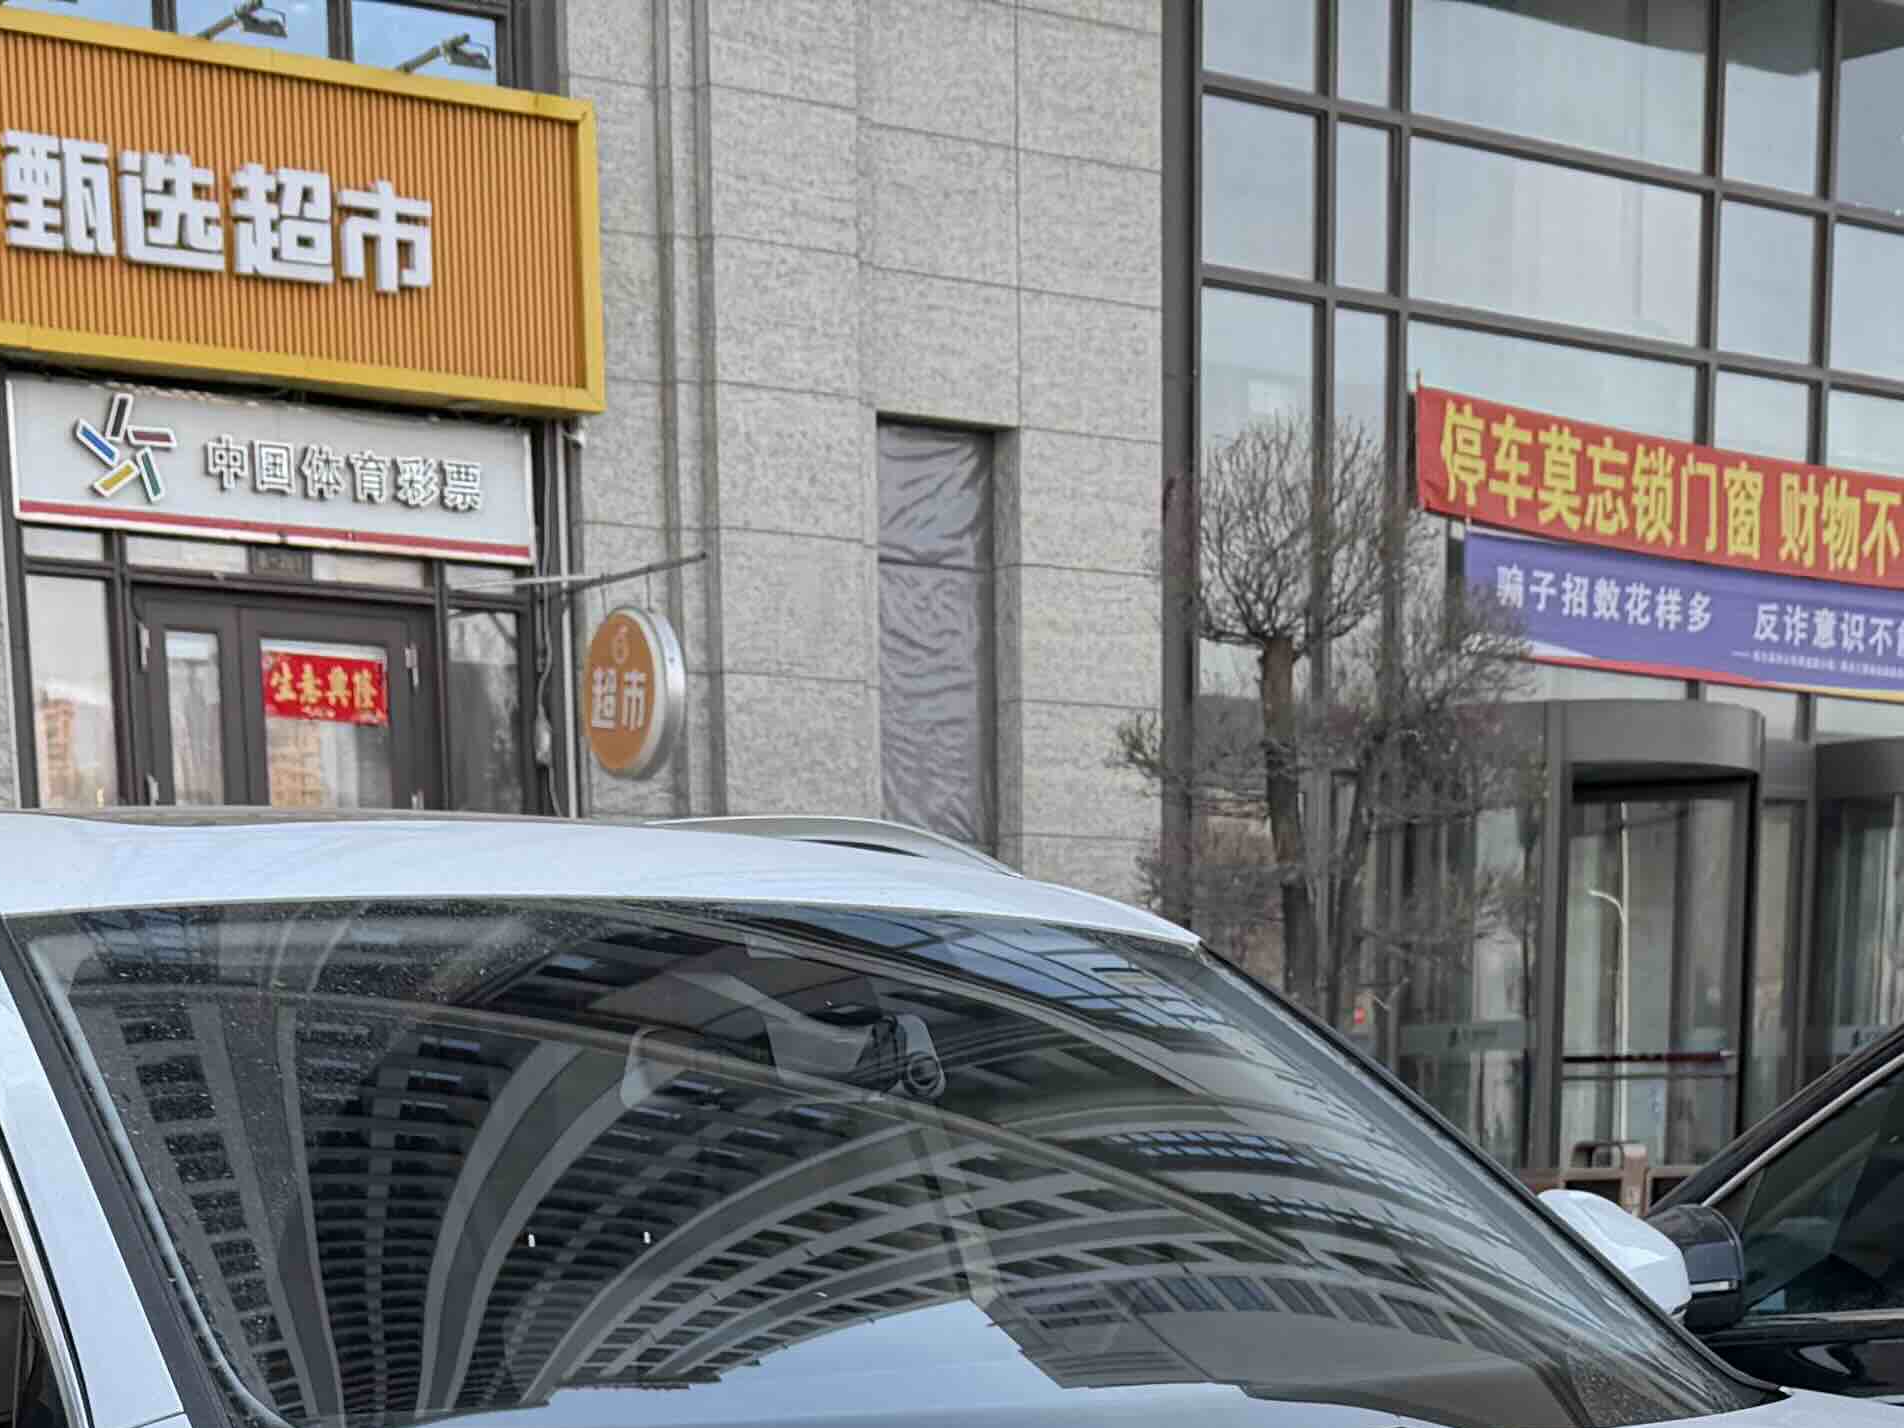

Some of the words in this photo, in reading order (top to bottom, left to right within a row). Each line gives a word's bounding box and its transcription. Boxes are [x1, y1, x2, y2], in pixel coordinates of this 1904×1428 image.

[0, 129, 431, 293] 甄选超市
[204, 434, 484, 512] 中国体育彩票
[1441, 399, 1764, 558] 停车莫忘锁门窗
[1495, 565, 1713, 633] 骗子招数花样多
[591, 667, 647, 731] 超市
